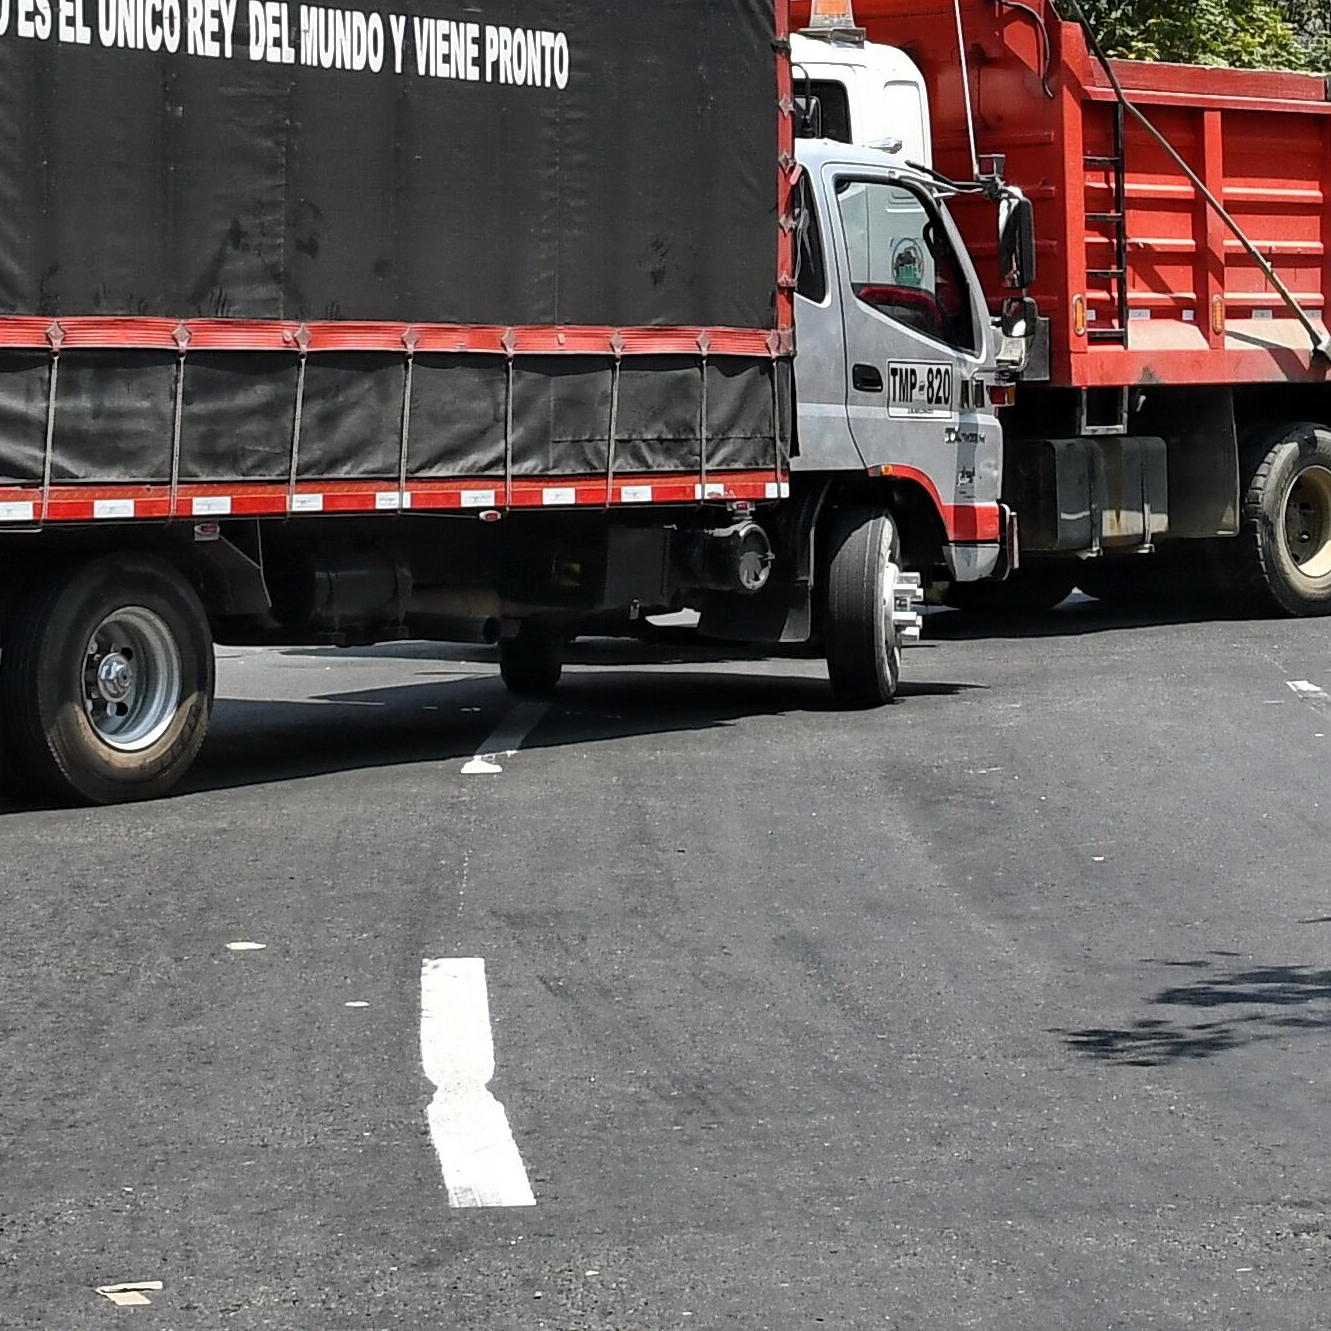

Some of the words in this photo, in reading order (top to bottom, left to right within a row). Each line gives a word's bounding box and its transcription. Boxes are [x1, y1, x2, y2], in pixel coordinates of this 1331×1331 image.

[249, 0, 295, 64] DEL
[300, 4, 384, 73] MUNDO
[389, 14, 406, 73] Y
[413, 17, 480, 81] VIENE
[485, 25, 569, 90] PRONTO
[891, 367, 917, 403] TMP
[926, 367, 950, 405] 820
